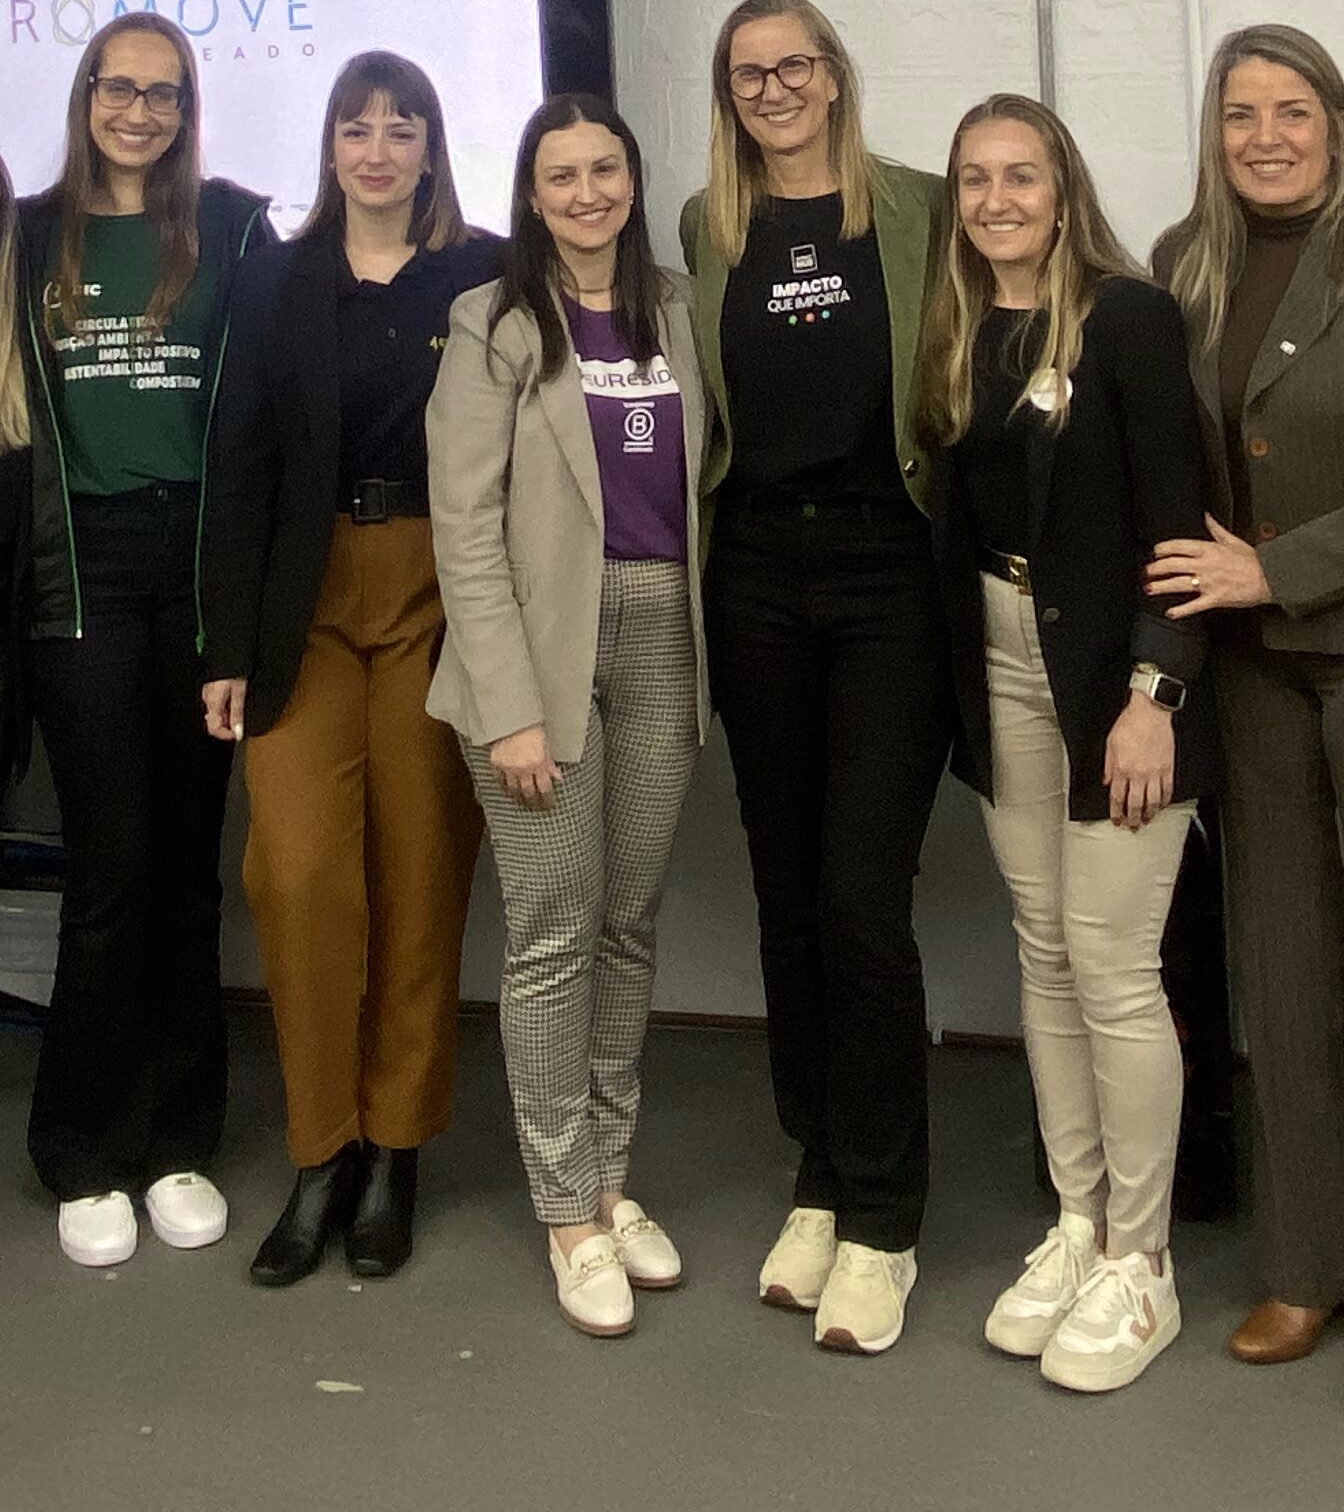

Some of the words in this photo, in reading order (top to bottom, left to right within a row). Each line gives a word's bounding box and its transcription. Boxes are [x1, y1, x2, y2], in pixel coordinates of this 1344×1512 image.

[202, 43, 316, 62] EADO
[772, 275, 843, 298] IMPACTO
[767, 297, 794, 313] QUE
[795, 290, 851, 310] IMPORTA
